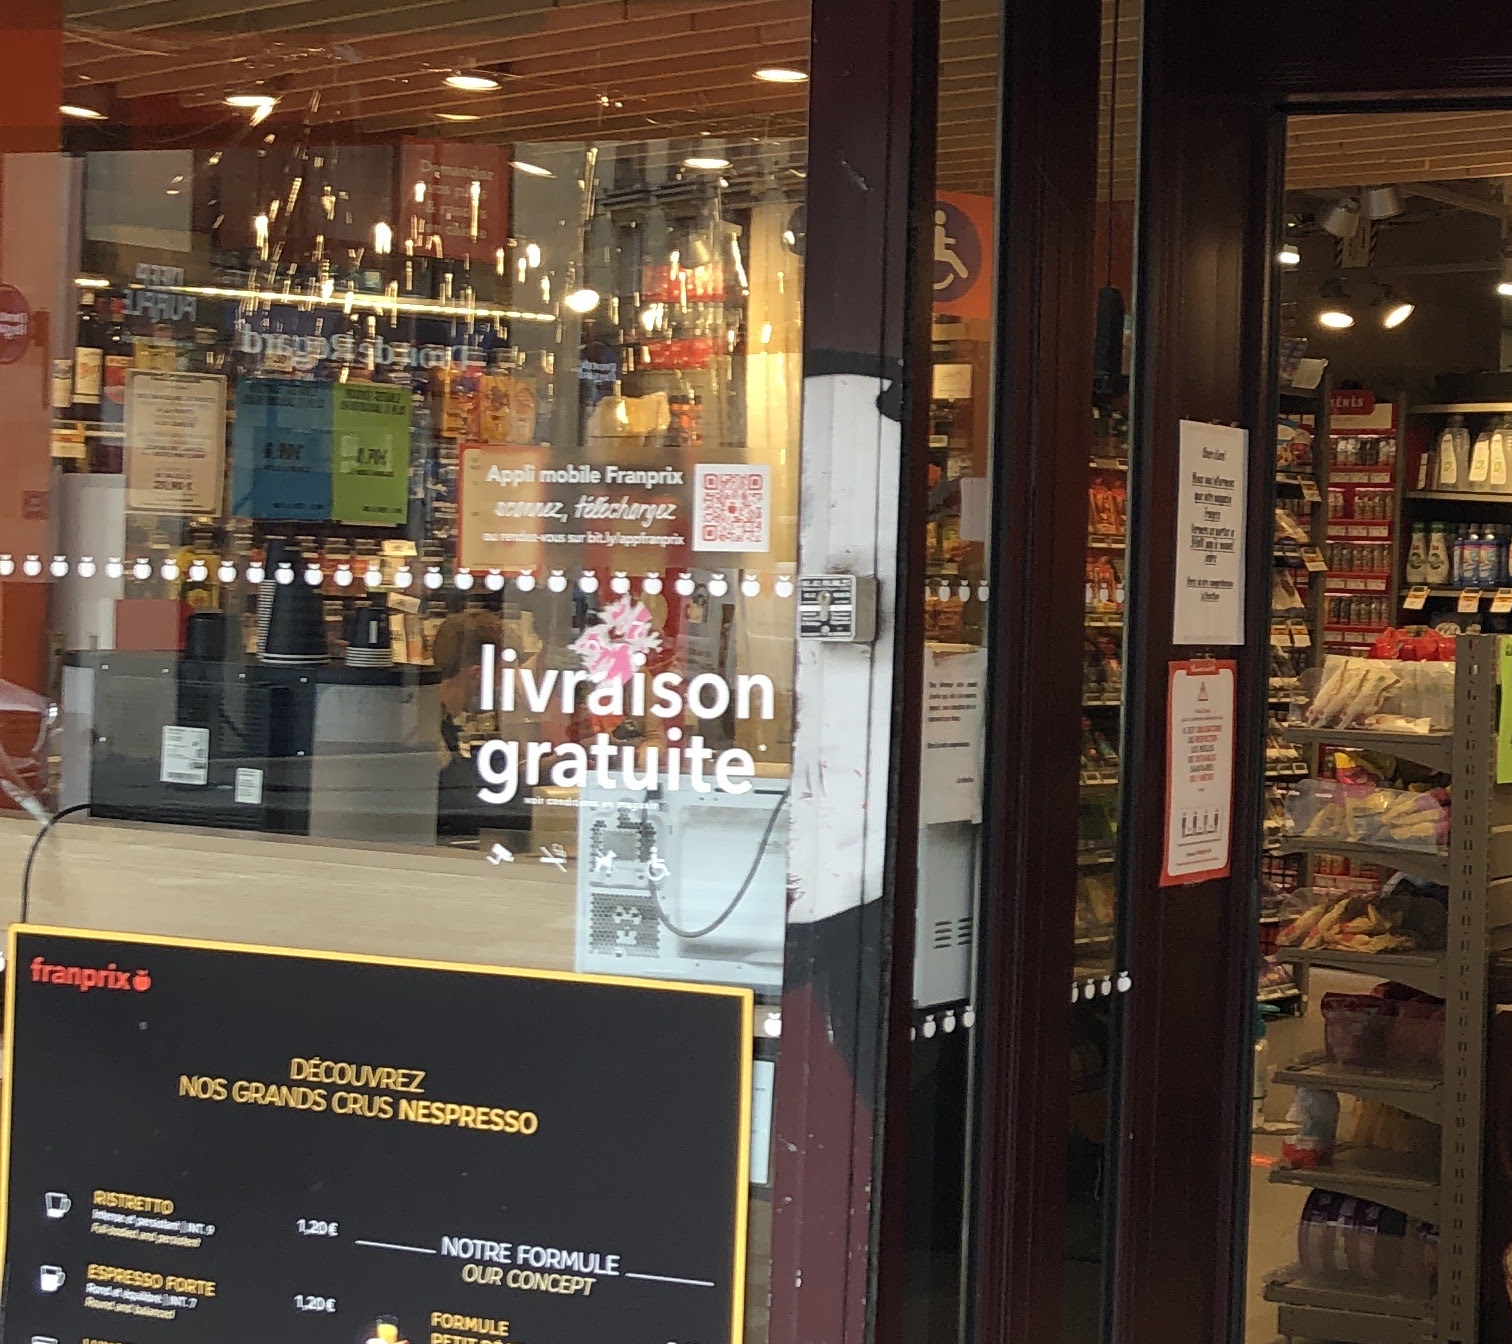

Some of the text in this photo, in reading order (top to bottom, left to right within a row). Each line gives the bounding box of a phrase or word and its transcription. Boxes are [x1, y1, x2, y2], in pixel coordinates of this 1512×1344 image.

[486, 463, 684, 490] Appli mobile Franprix
[479, 643, 775, 720] livraison
[476, 726, 756, 805] gratuite
[30, 957, 131, 992] franprix
[290, 1056, 426, 1093] DÉCOUVREZ
[178, 1074, 539, 1135] NOS GRANDS CRUS NESPRESSO
[93, 1189, 174, 1215] RISTRETTO
[440, 1236, 622, 1276] NOTRE FORMULE
[87, 1263, 216, 1296] ESPRESSO FORTE
[461, 1263, 598, 1297] OUR CONCEPT
[430, 1311, 510, 1337] FORMULE
